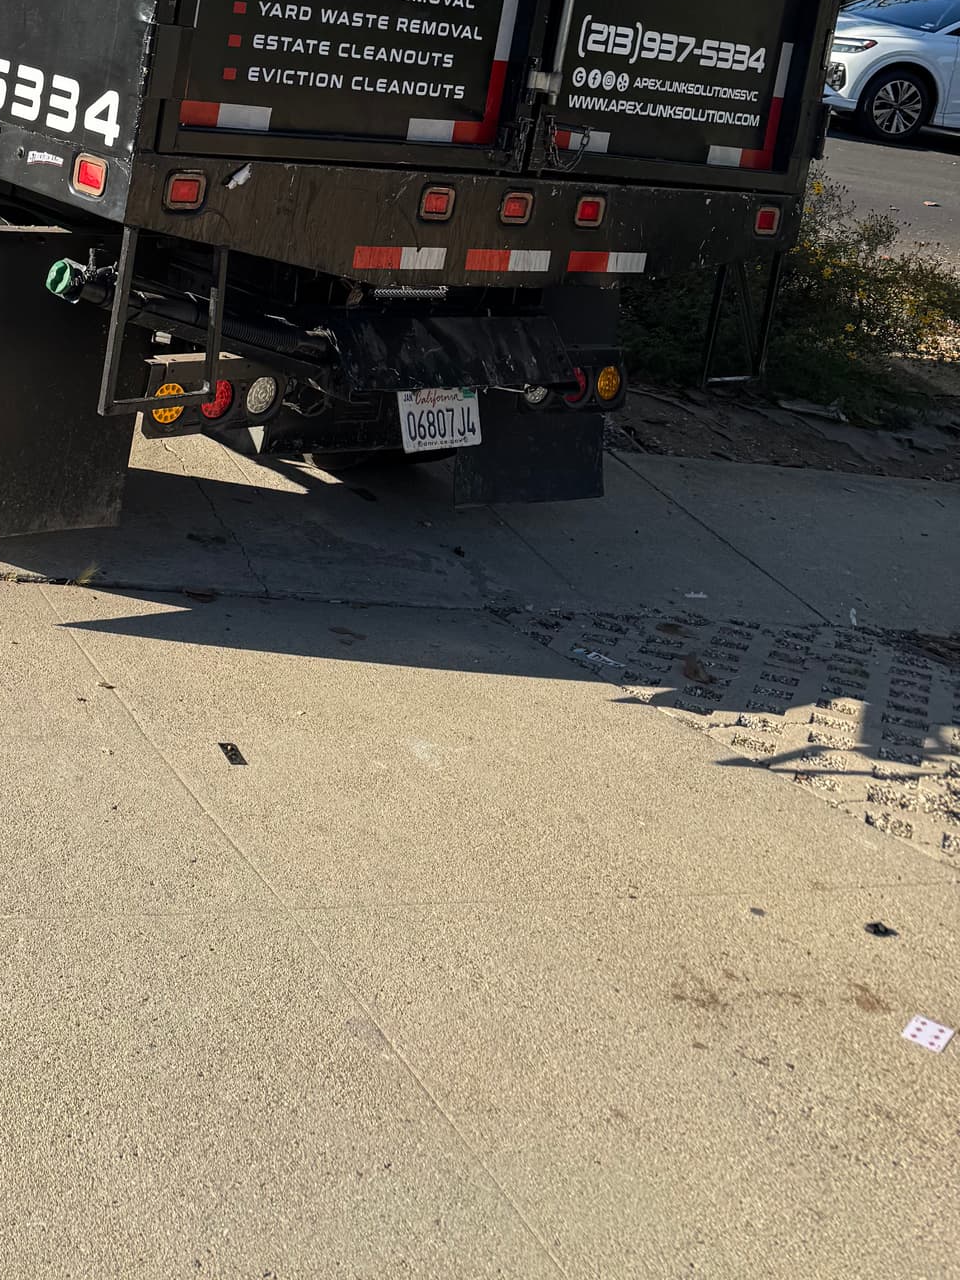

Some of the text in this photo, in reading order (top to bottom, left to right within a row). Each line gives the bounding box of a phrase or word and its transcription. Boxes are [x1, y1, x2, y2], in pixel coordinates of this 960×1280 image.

[258, 0, 484, 41] YARD WASTE REMOVAL
[252, 33, 455, 68] ESTATE CLEANOUTS
[577, 14, 767, 74] (213)937-5334
[247, 66, 466, 100] EVICTION CLEANOUTS
[633, 77, 760, 103] APEXJUNKSOLUTIONSSVC
[568, 94, 761, 127] WWW.APEXJUNKSOLUTION.COM
[415, 388, 464, 409] California
[407, 406, 477, 442] 06807J4
